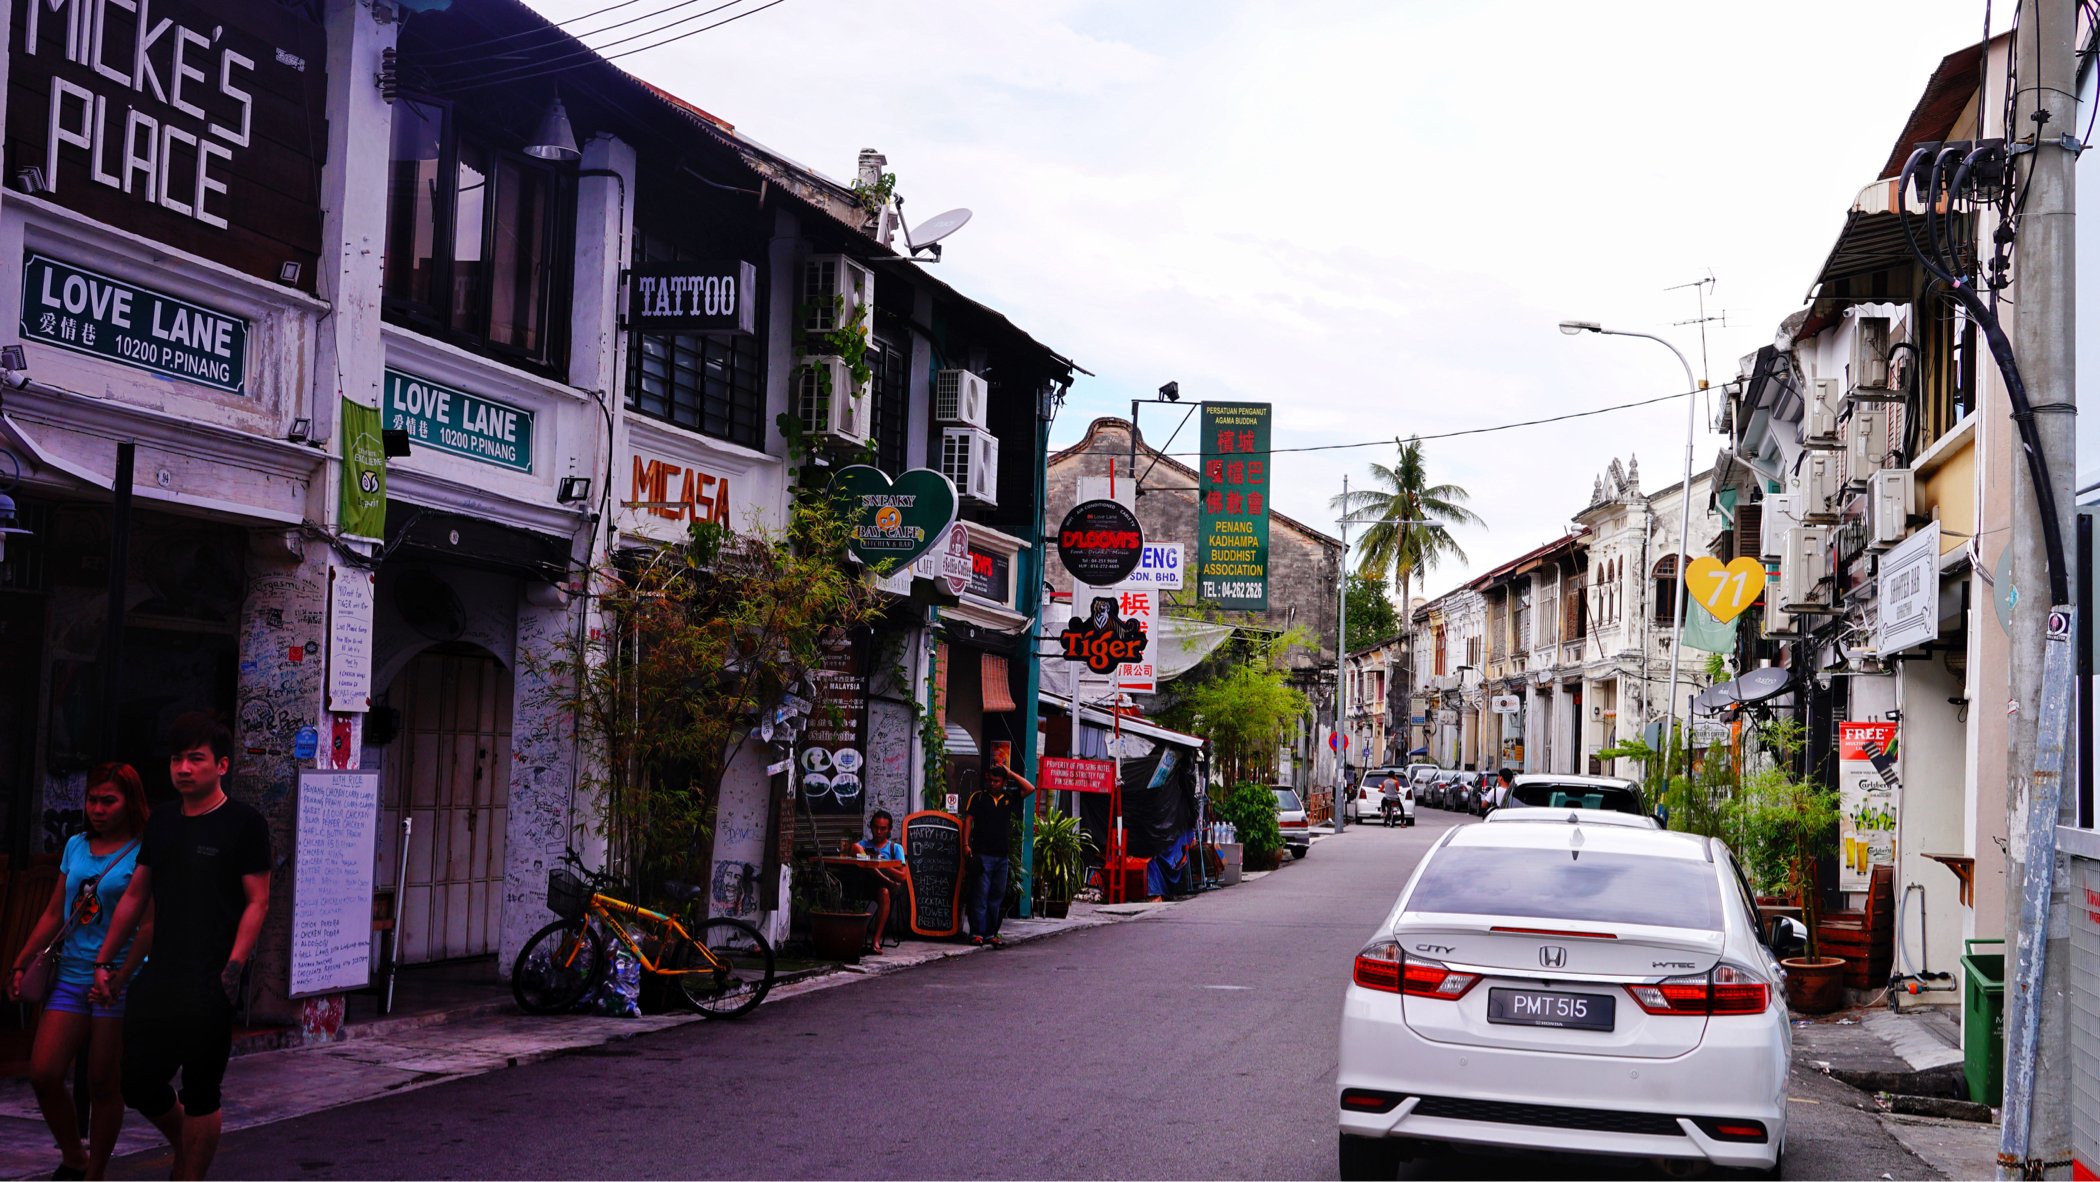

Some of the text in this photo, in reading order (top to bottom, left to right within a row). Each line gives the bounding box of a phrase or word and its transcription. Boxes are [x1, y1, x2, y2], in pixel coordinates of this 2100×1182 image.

[25, 0, 254, 148] MICKE'S
[46, 75, 232, 230] PLACE
[639, 275, 736, 316] TATTOO
[41, 266, 233, 358] LOVE LANE
[115, 334, 230, 383] 10200 P.PINANG
[393, 378, 517, 443] LOVE LANE
[1206, 406, 1267, 416] PERSATUAN PENGANUT
[1215, 416, 1258, 425] AGAMA BUDDHA
[440, 427, 516, 462] 10200 P.PINANG
[862, 494, 917, 507] SNEAKY
[857, 525, 881, 538] BAY
[1215, 521, 1253, 533] PENANG
[1209, 535, 1260, 548] KADHAMPA
[1138, 547, 1178, 568] ENG
[1211, 549, 1257, 562] BUDDHIST
[1155, 573, 1179, 582] BHD.
[1203, 563, 1264, 577] ASSOCIATION
[1222, 581, 1245, 598] 04-262
[1246, 582, 1263, 599] 2626
[1707, 570, 1749, 608] 71
[1062, 630, 1141, 670] Tiger
[829, 682, 860, 690] MALAYSIA
[1755, 676, 1777, 686] astro
[1415, 944, 1456, 954] CITY
[1513, 995, 1588, 1018] PMT 515
